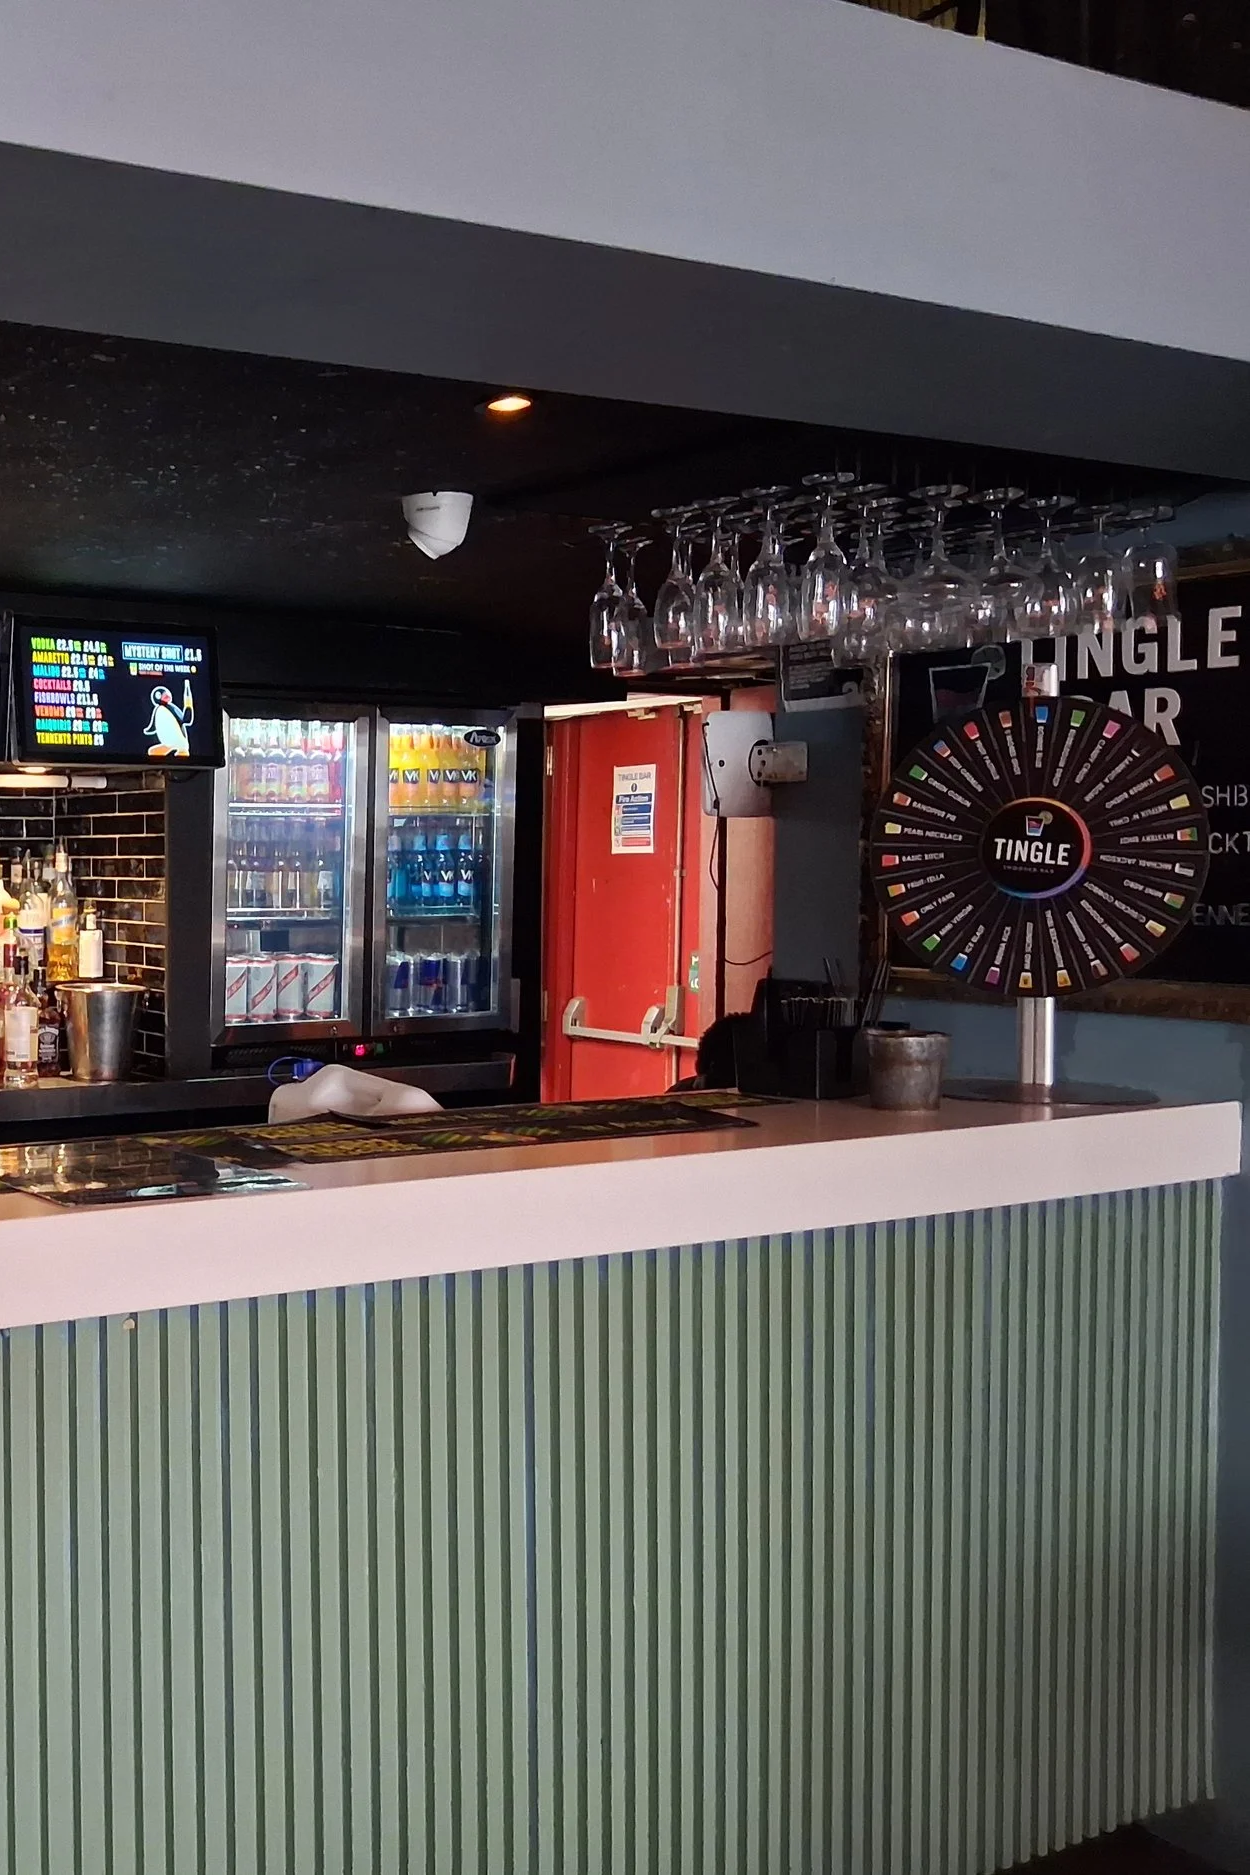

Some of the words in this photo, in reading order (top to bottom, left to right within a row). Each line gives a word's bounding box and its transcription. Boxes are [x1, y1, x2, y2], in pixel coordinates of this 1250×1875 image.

[31, 637, 55, 650] VODKA
[32, 651, 69, 664] AMARETTO
[124, 645, 160, 658] MYSTERY
[161, 647, 180, 660] SHOT
[33, 664, 60, 677] MALIBU
[34, 679, 71, 690] COCKTAILS
[35, 692, 75, 704] FISHBOWLS
[35, 705, 64, 717] VENOMS
[73, 734, 92, 745] PINTS
[405, 769, 419, 780] VK
[461, 769, 476, 780] VK
[994, 838, 1070, 866] TINGLE
